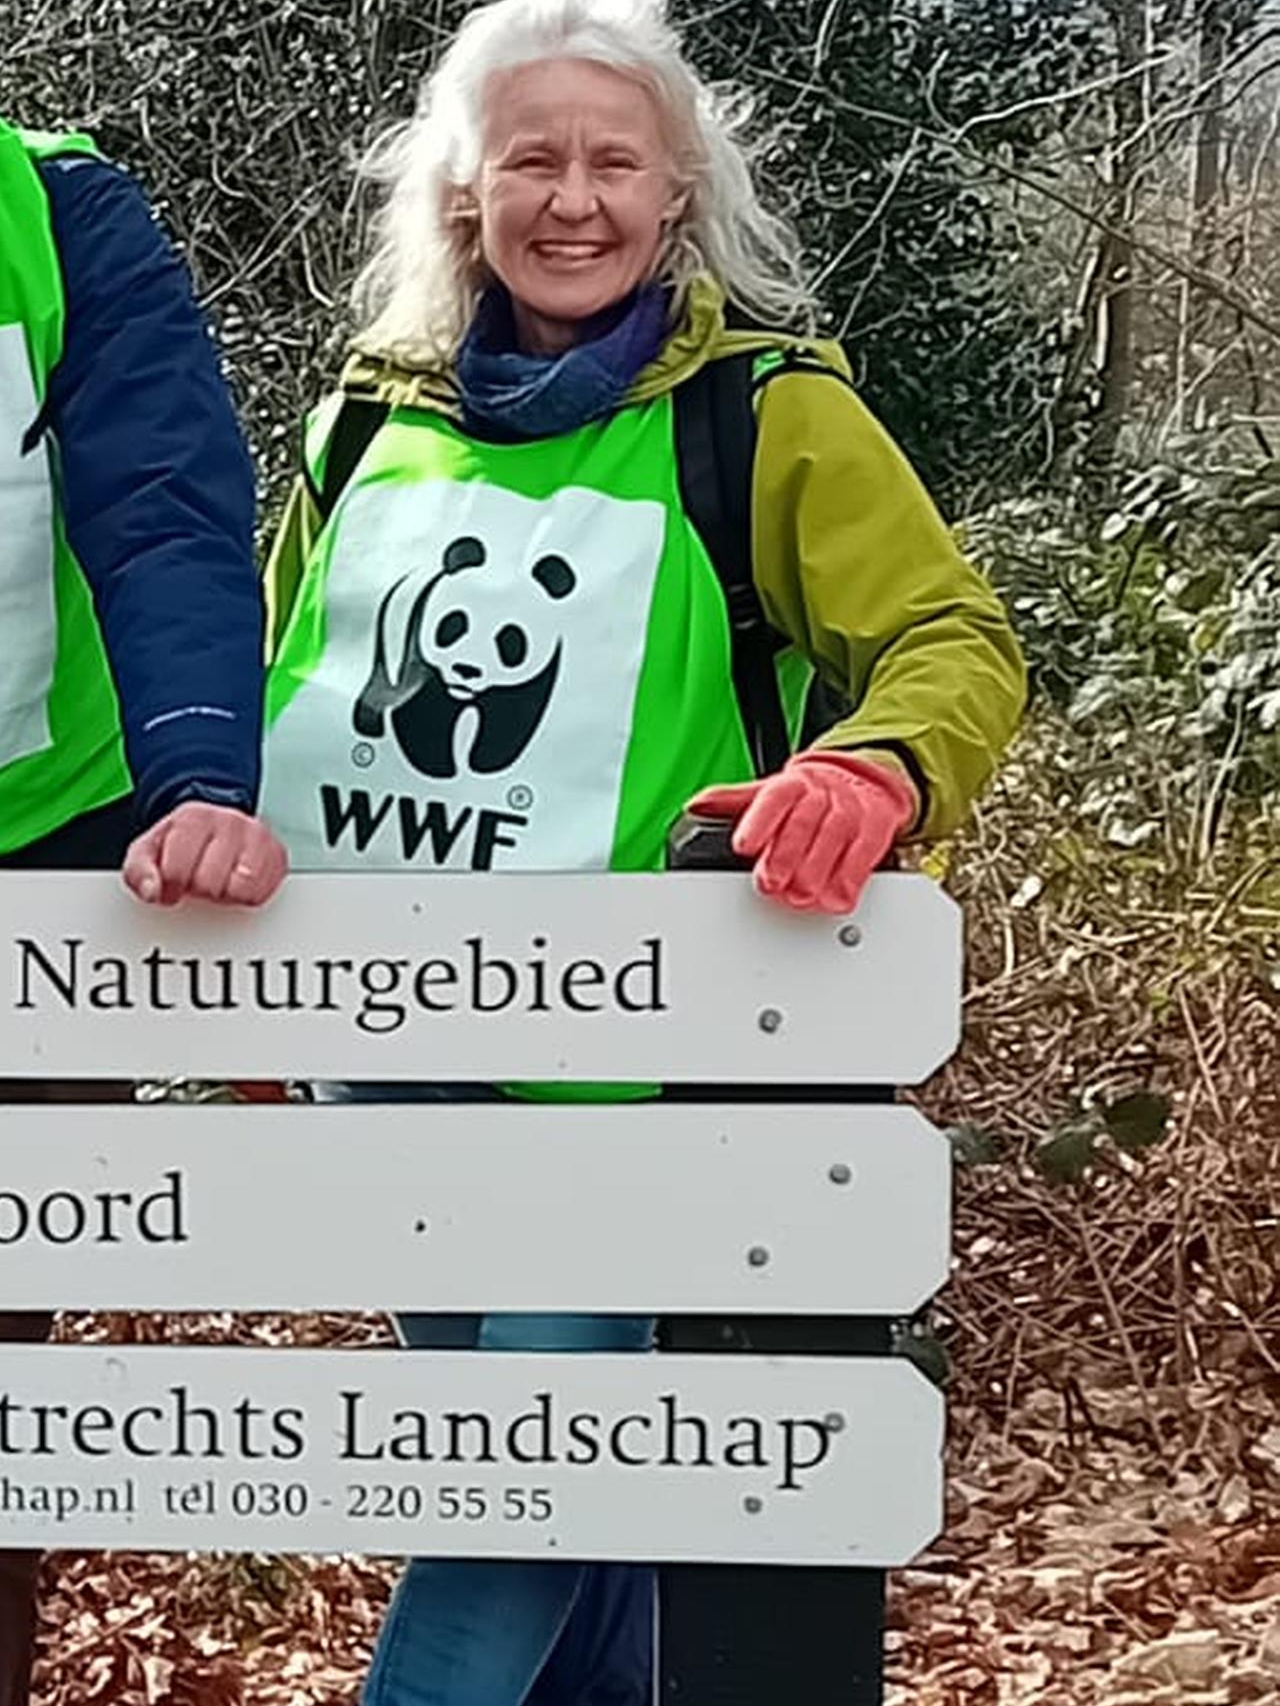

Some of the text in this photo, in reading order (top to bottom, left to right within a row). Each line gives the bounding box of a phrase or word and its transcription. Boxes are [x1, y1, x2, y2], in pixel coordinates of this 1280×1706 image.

[320, 785, 529, 871] WWF
[15, 937, 668, 1034] Natuurgebied
[339, 1390, 832, 1491] Landschap
[231, 1482, 308, 1516] 030
[347, 1484, 422, 1518] 220
[438, 1487, 486, 1520] 55
[503, 1488, 553, 1521] 55
